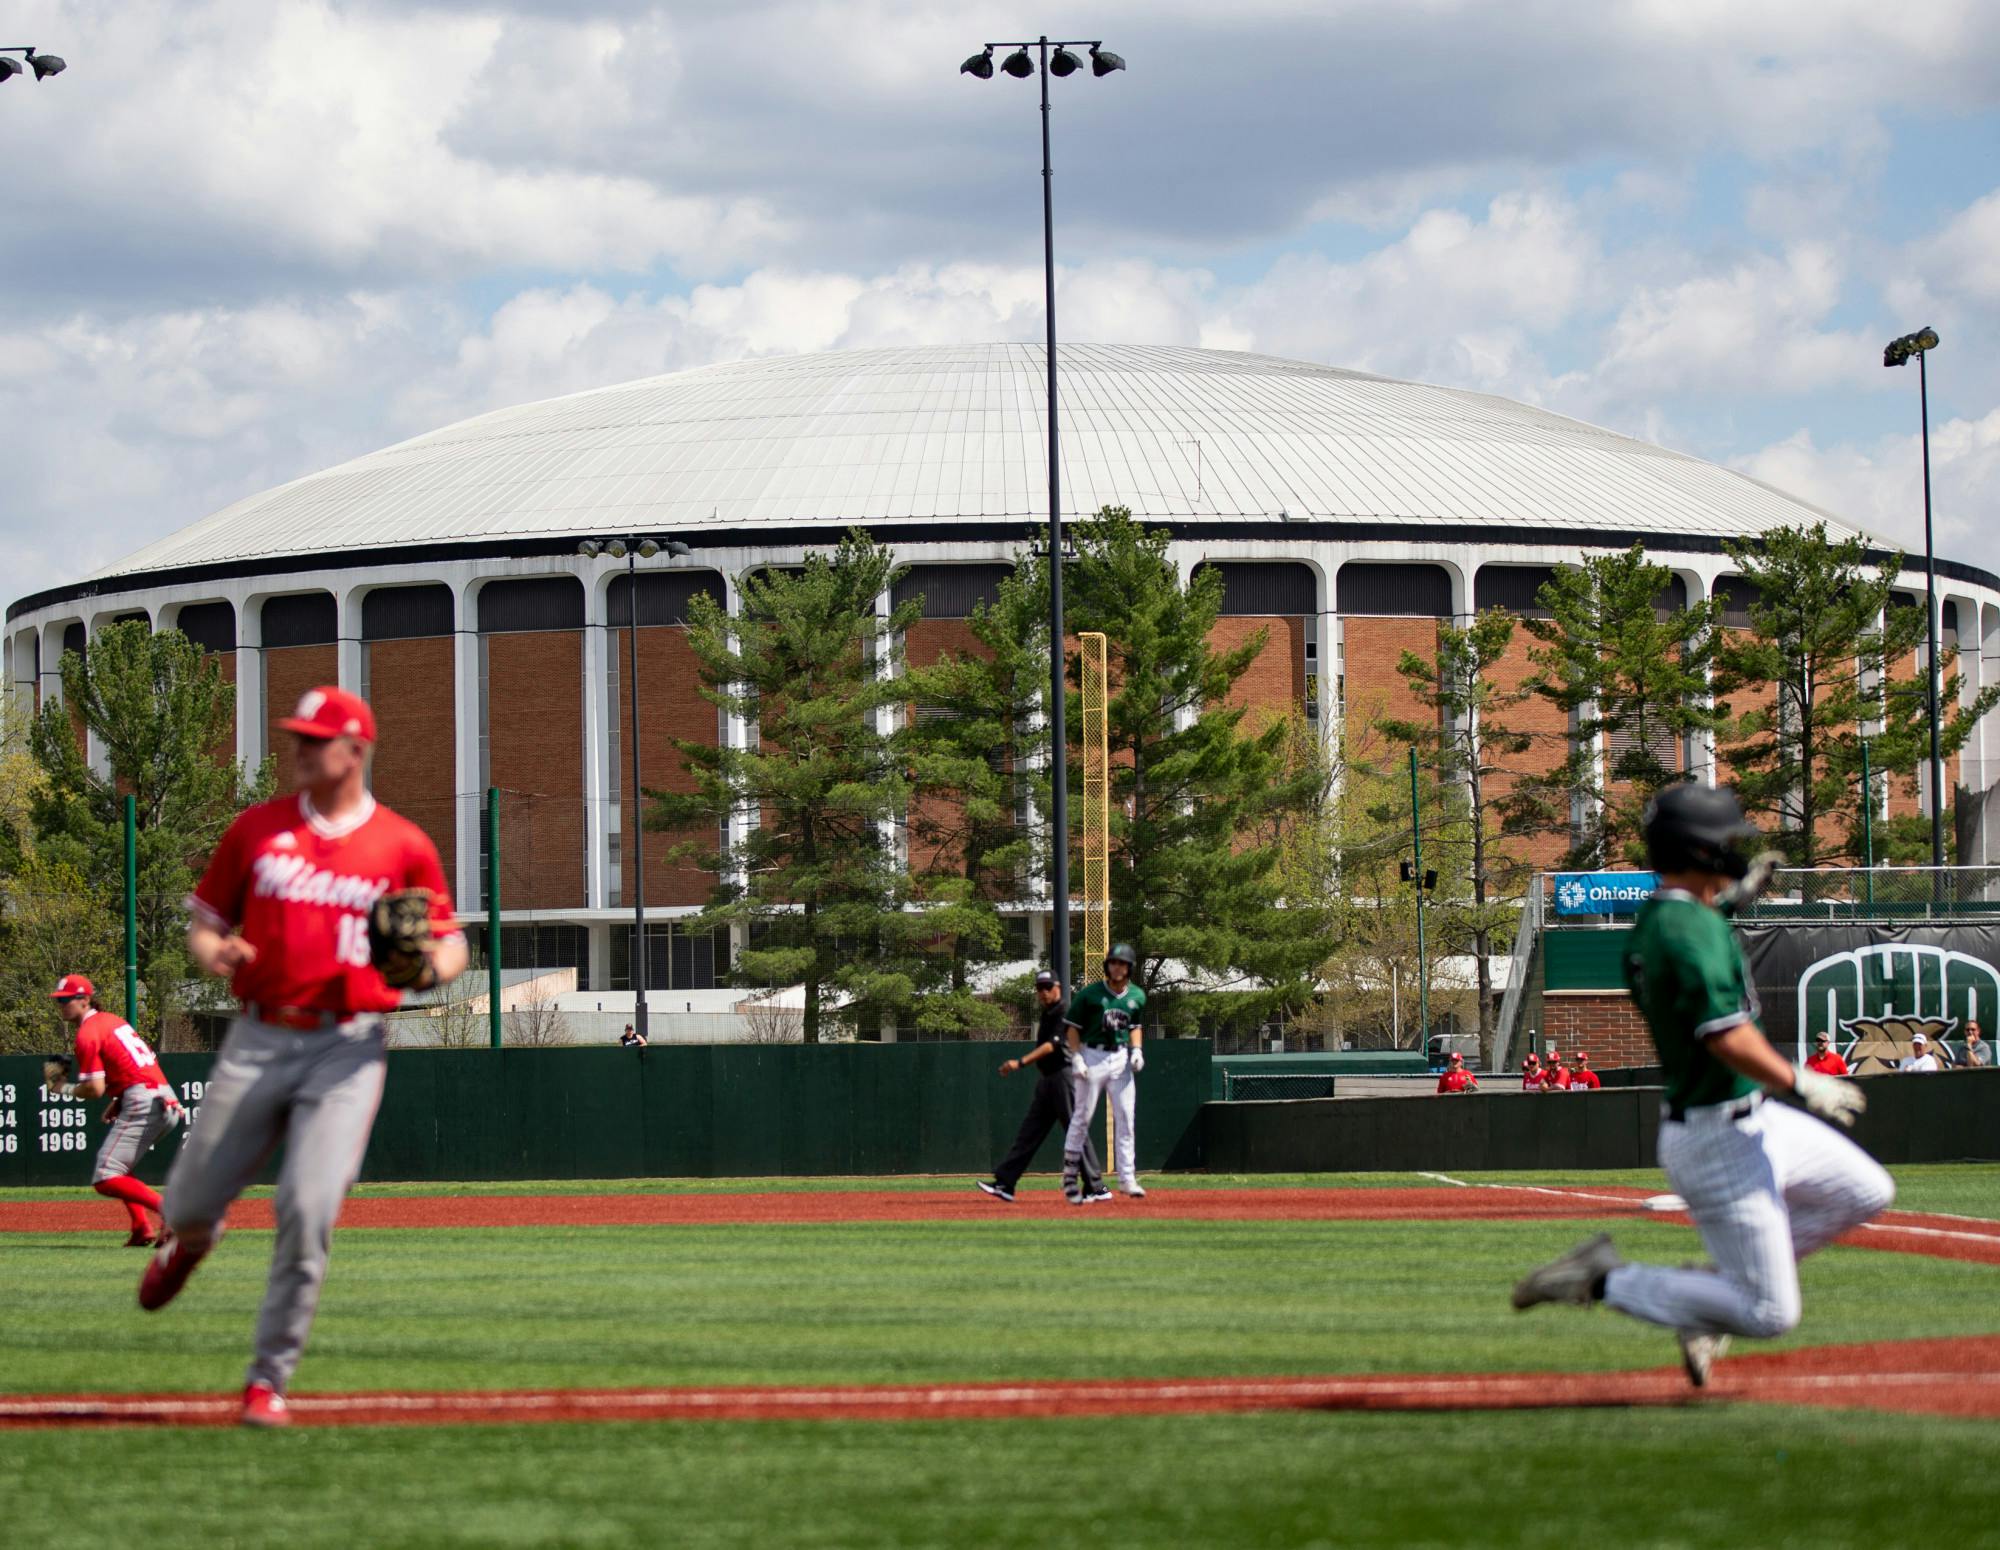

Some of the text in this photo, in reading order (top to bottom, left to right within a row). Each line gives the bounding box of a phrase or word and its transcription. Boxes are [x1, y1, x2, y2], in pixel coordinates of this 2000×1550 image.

[254, 853, 390, 910] Miami
[1798, 943, 2000, 1075] OHIO
[39, 1108, 87, 1128] 1965
[39, 1132, 87, 1152] 1968
